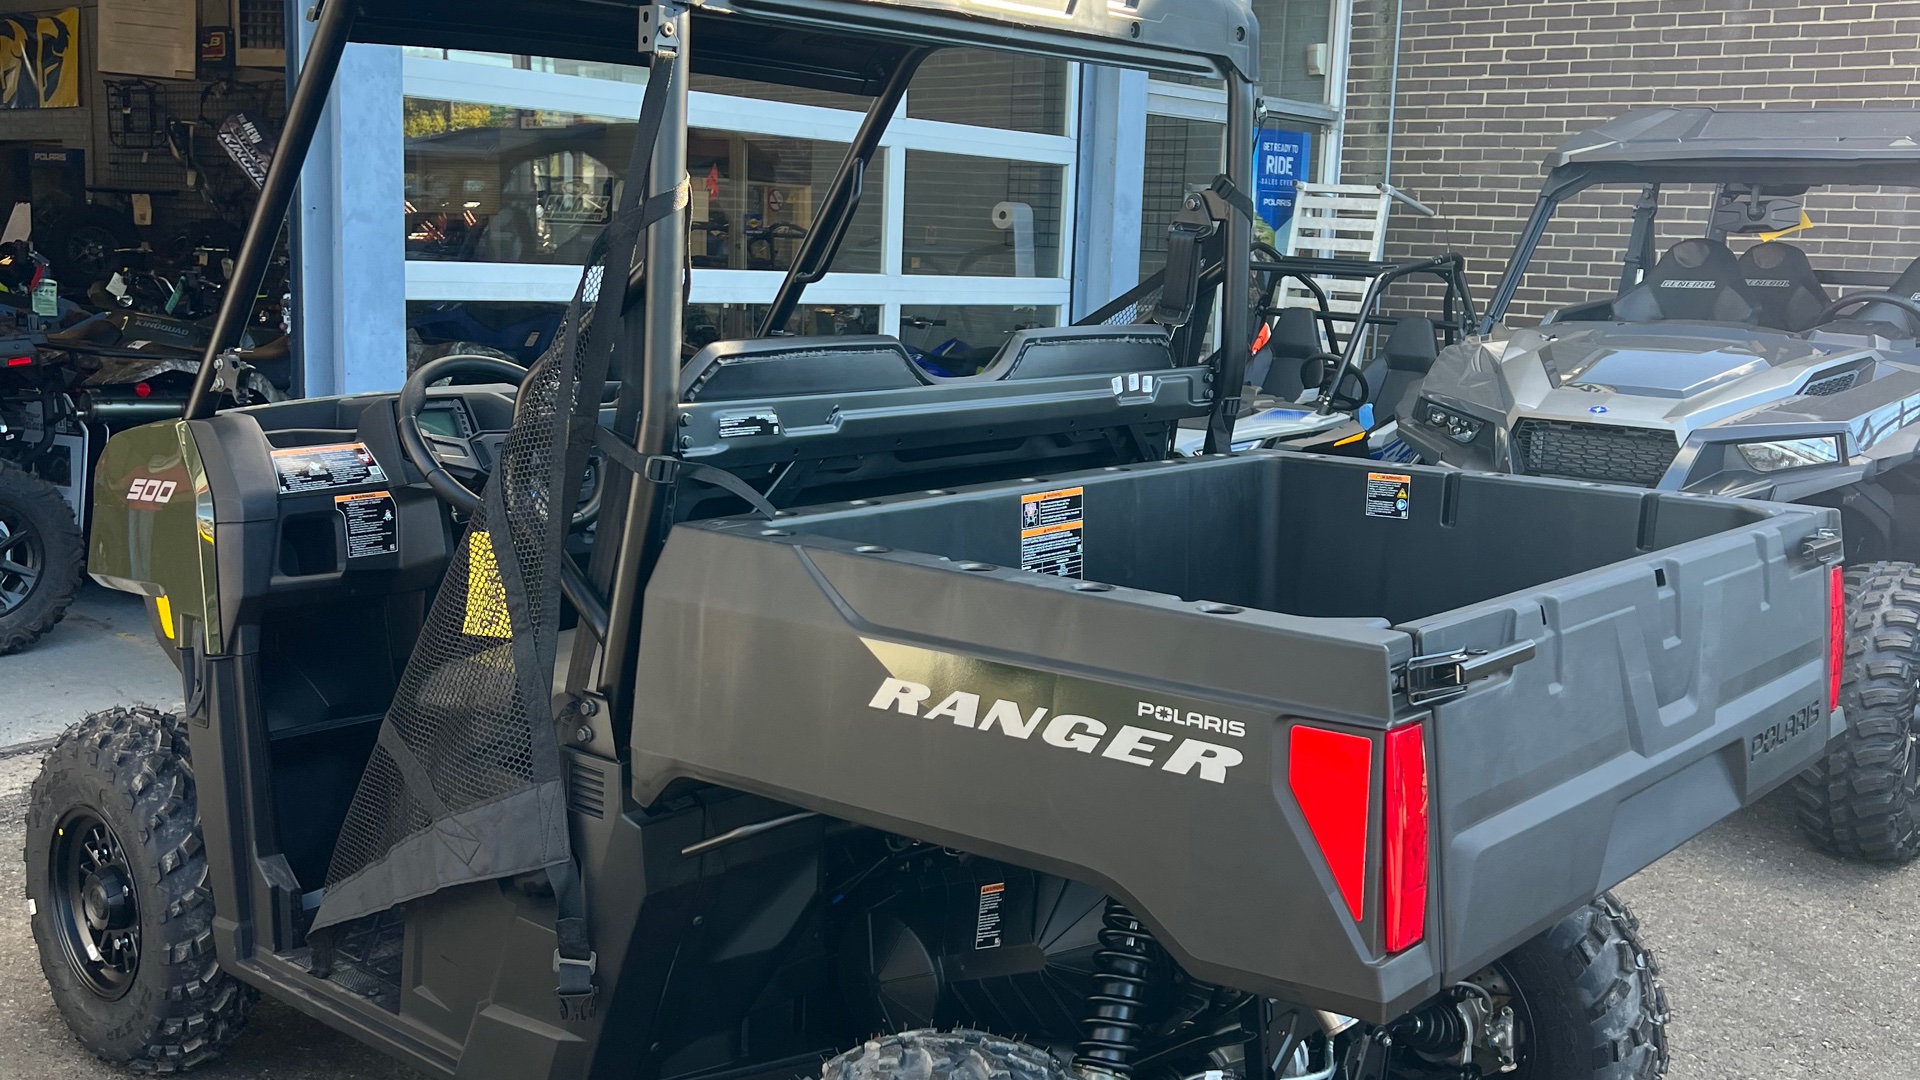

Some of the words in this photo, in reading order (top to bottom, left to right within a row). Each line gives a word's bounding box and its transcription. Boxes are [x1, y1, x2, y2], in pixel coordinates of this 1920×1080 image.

[242, 121, 263, 144] NEW
[1263, 142, 1274, 152] GET
[1274, 142, 1291, 154] READY
[1292, 144, 1299, 154] TO
[34, 152, 67, 161] POLARIS
[1266, 155, 1294, 176] RIDE
[1260, 177, 1278, 186] SALES
[1263, 198, 1292, 207] POLARIS
[1660, 279, 1716, 289] GENERAL
[1745, 278, 1790, 288] ENERAL
[134, 320, 190, 336] KINGQUAD
[126, 478, 178, 504] 500
[1137, 701, 1247, 738] POLARIS
[868, 677, 1244, 785] RANGER
[1750, 699, 1820, 762] POLARIS
